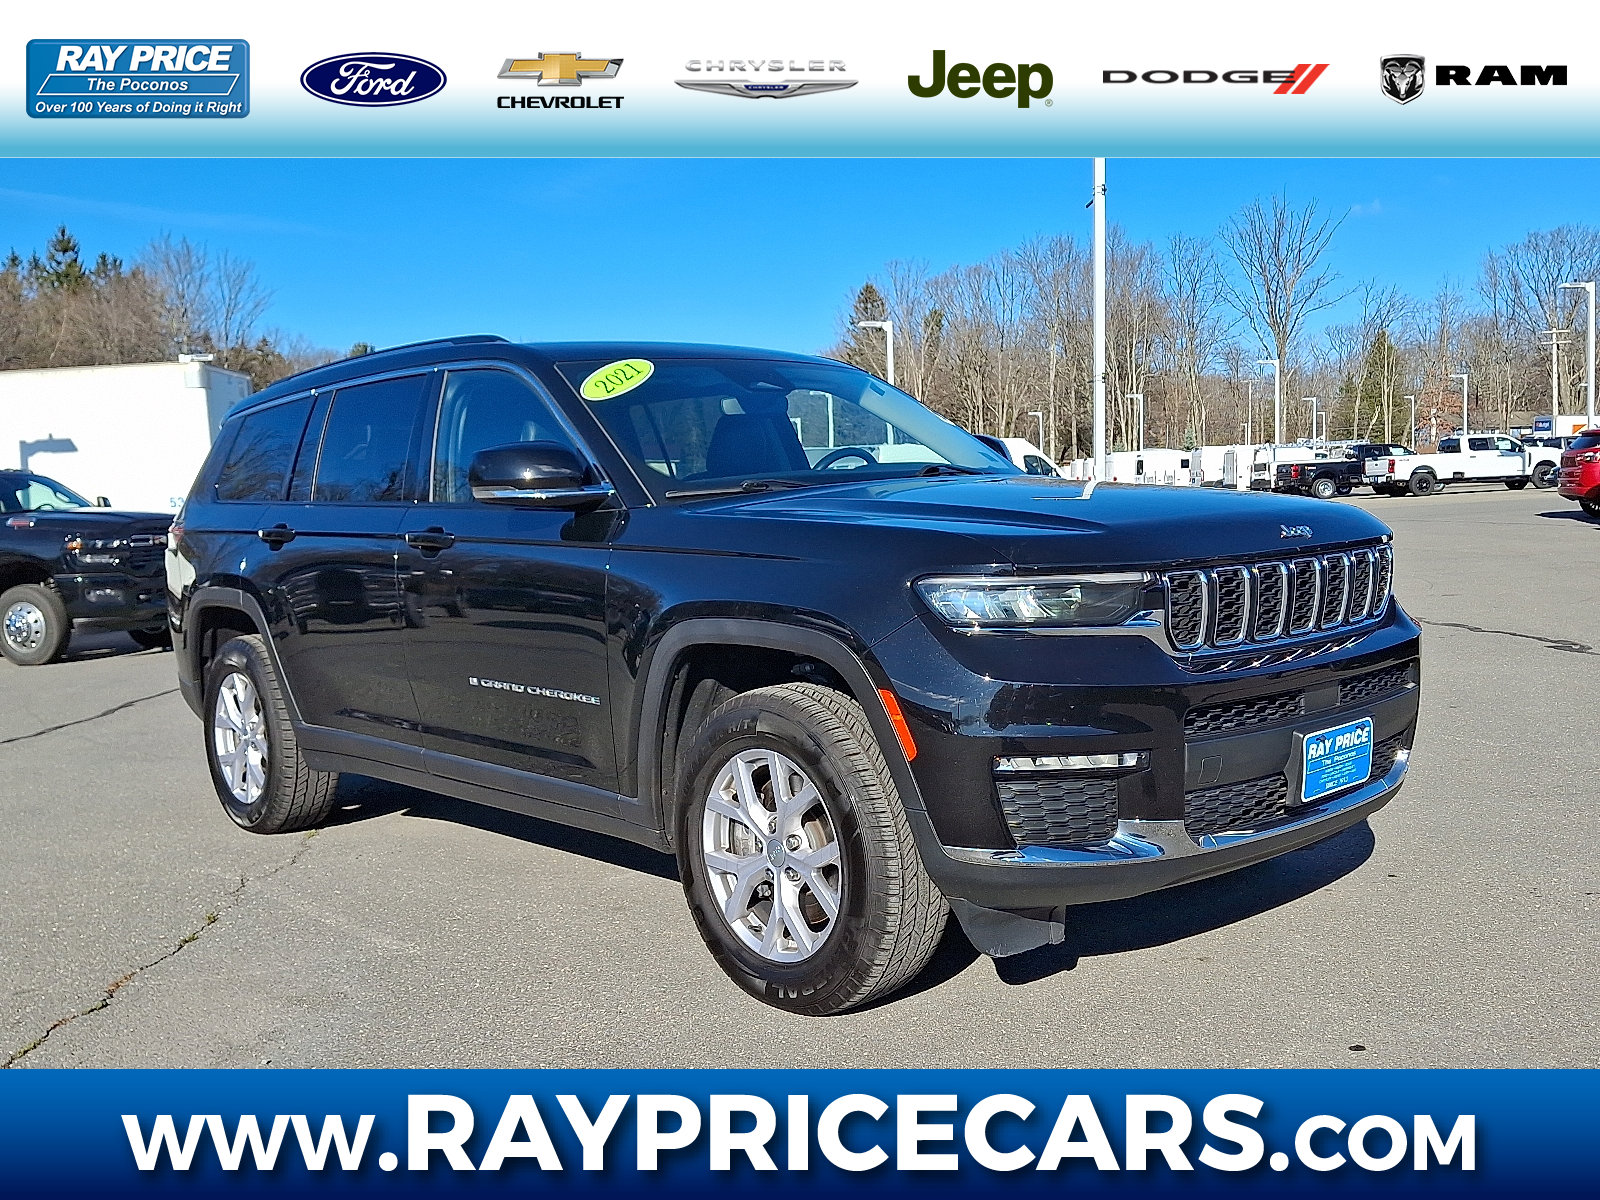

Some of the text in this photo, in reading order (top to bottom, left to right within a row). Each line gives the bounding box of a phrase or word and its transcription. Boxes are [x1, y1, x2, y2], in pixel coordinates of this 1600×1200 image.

[594, 363, 643, 394] 2021
[480, 679, 525, 692] GRAND
[526, 686, 601, 706] CHEROKEE
[1308, 727, 1370, 760] RAY PRICE
